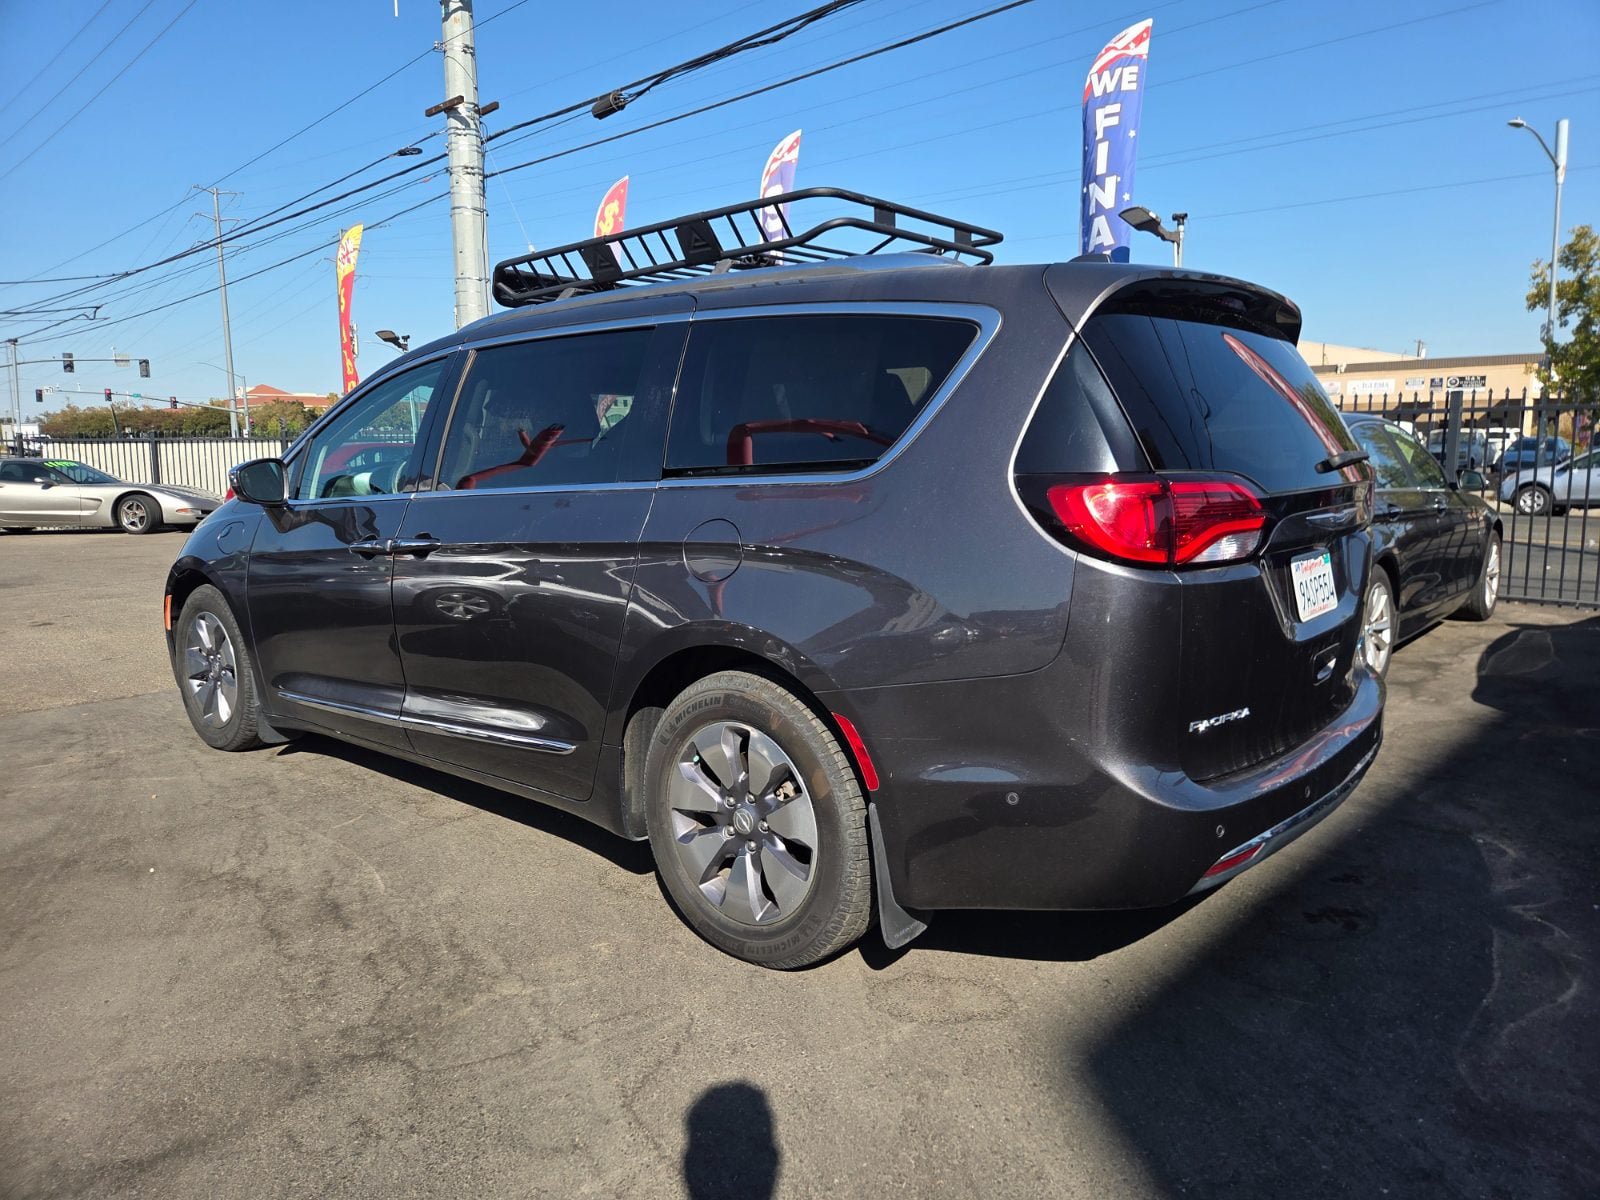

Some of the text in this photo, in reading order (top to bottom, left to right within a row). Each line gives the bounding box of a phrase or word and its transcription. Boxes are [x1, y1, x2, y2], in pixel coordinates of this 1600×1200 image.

[1090, 65, 1139, 97] WE
[1087, 103, 1122, 255] FINA
[1299, 572, 1335, 611] 9ASP554
[674, 696, 722, 726] MICHELIN
[1188, 706, 1251, 734] PACIFICA
